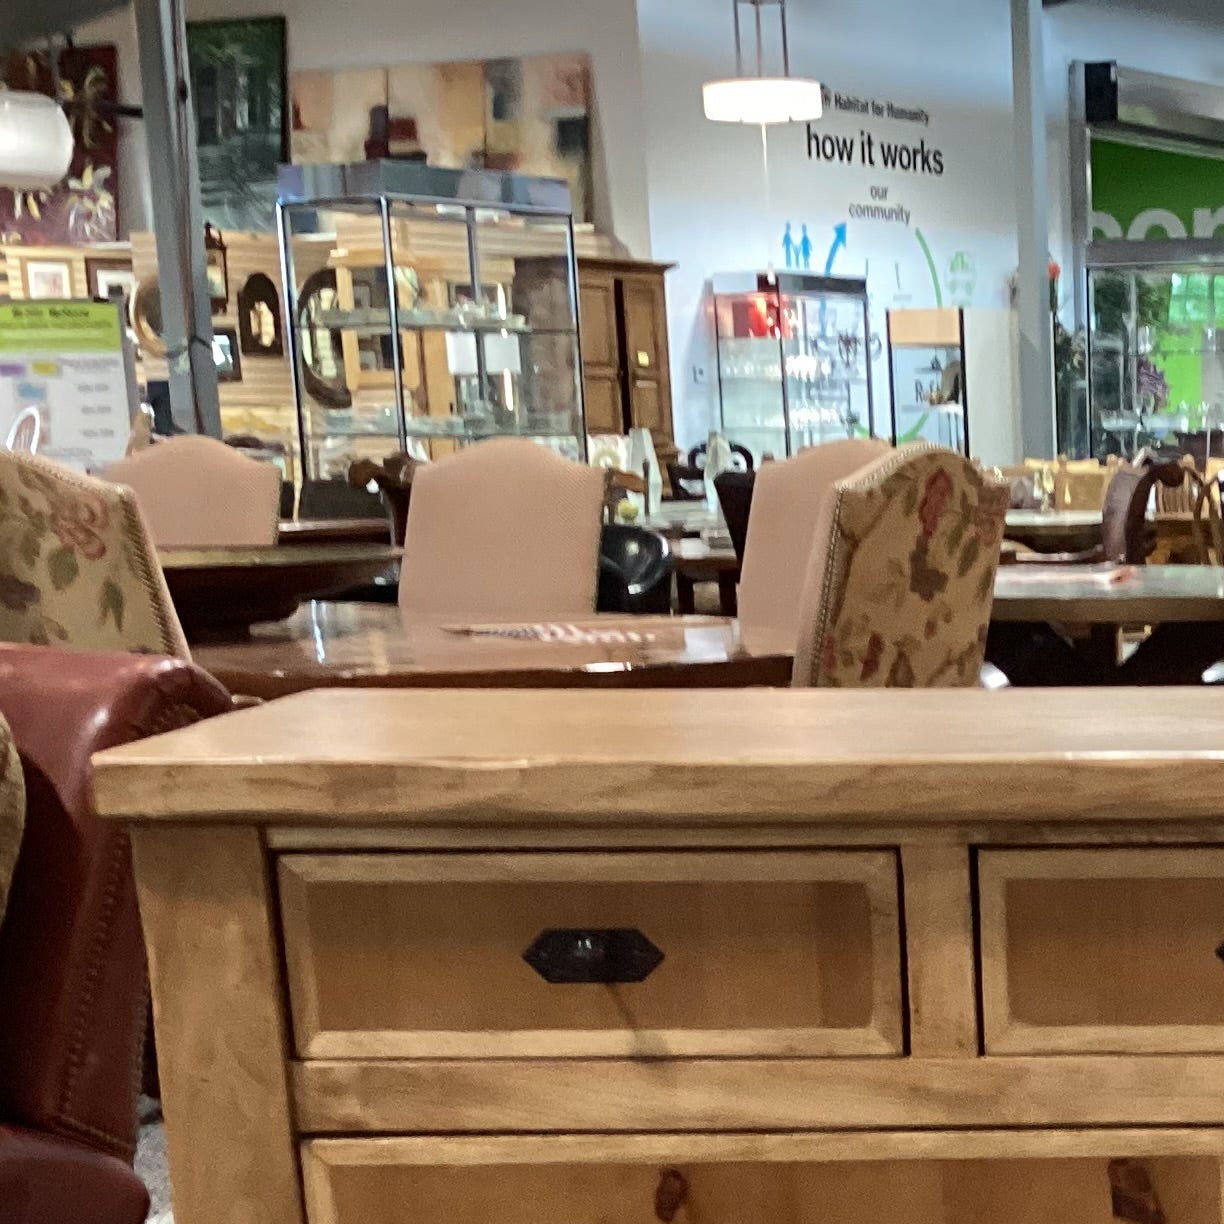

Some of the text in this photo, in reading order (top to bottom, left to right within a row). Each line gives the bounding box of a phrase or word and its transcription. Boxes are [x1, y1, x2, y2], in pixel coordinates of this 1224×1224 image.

[806, 122, 944, 177] how it works
[870, 185, 888, 201] our
[849, 203, 910, 225] community
